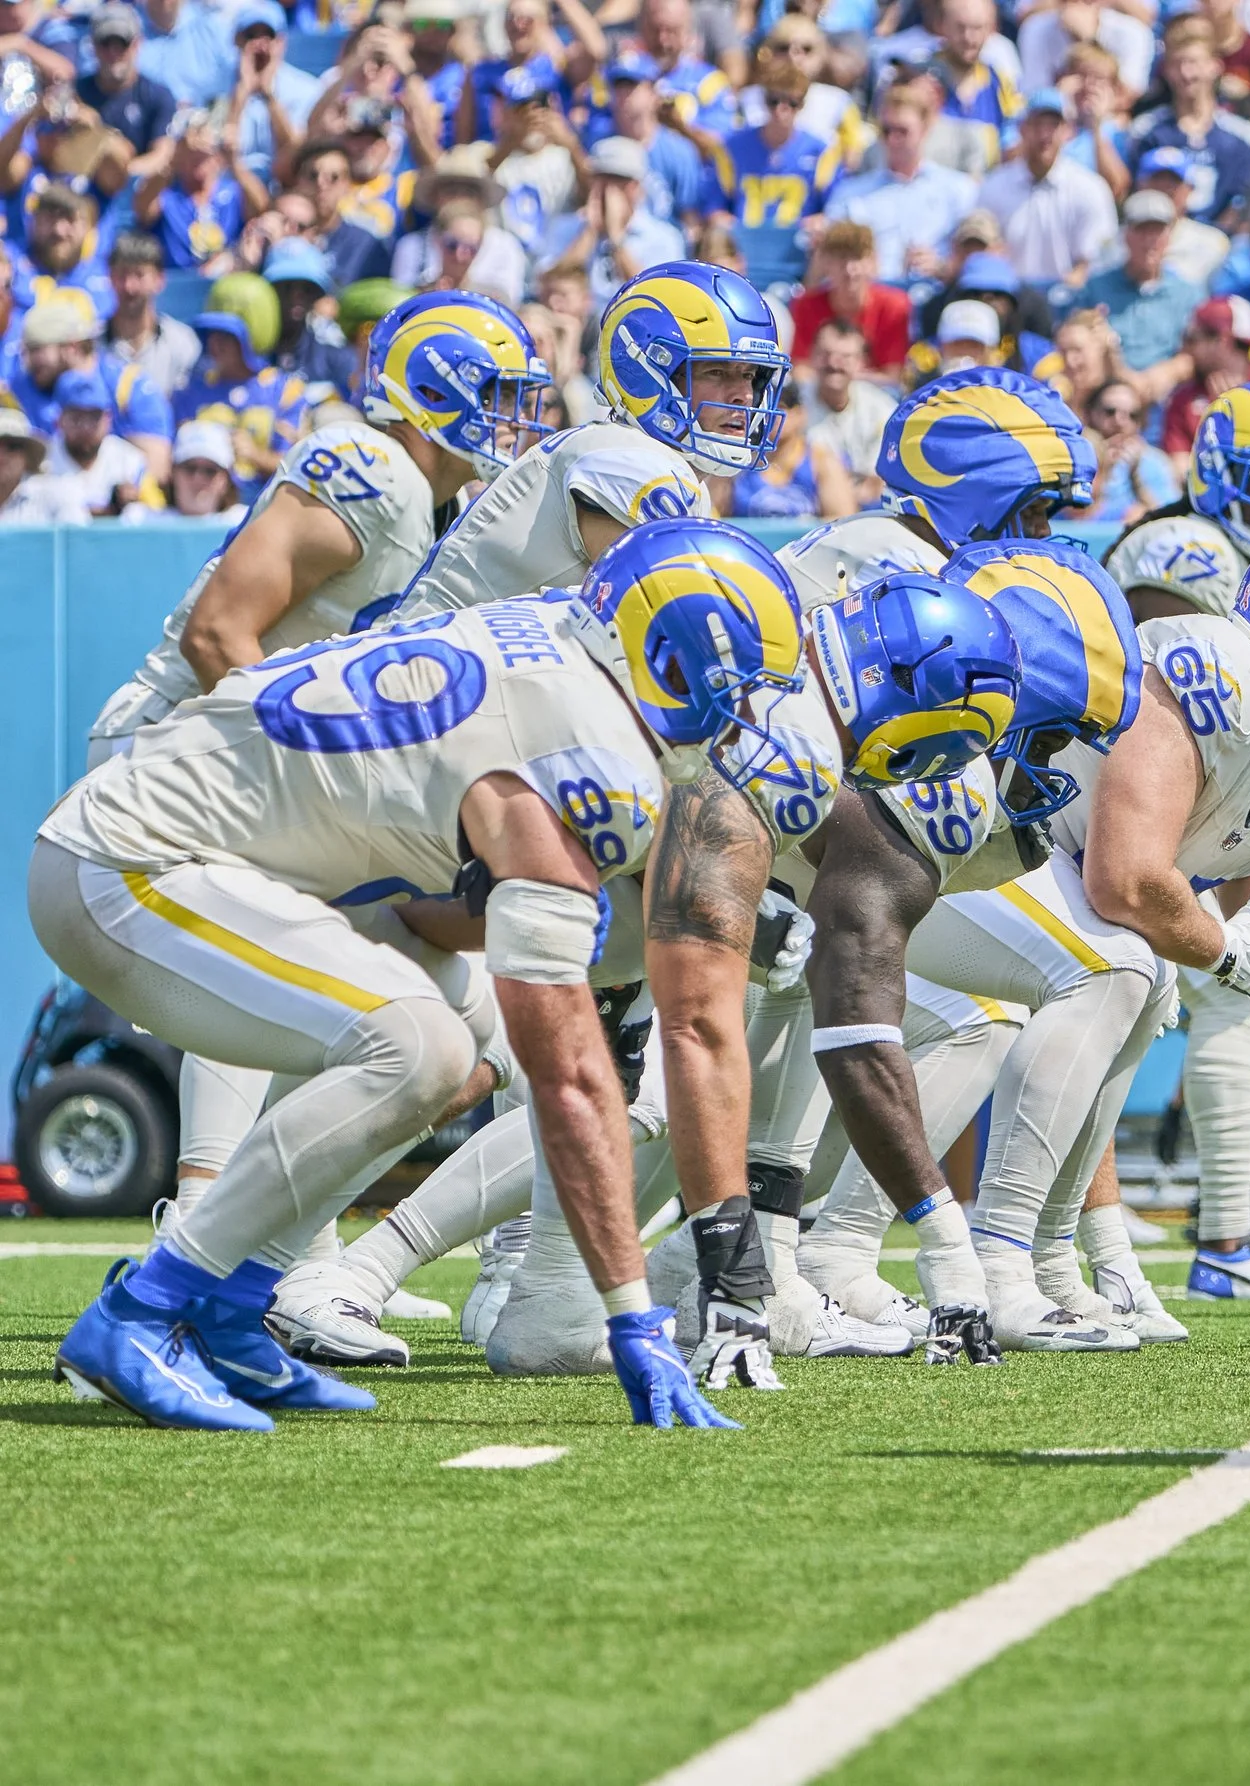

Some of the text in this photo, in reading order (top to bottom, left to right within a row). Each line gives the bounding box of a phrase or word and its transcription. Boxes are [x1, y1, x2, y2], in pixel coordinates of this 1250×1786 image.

[741, 173, 808, 229] 17
[301, 448, 384, 502] 87
[1163, 544, 1219, 583] 17
[240, 611, 487, 754] 9
[818, 633, 851, 709] ANGELES
[1164, 643, 1231, 737] 65
[557, 776, 627, 872] 89
[747, 742, 819, 836] 79
